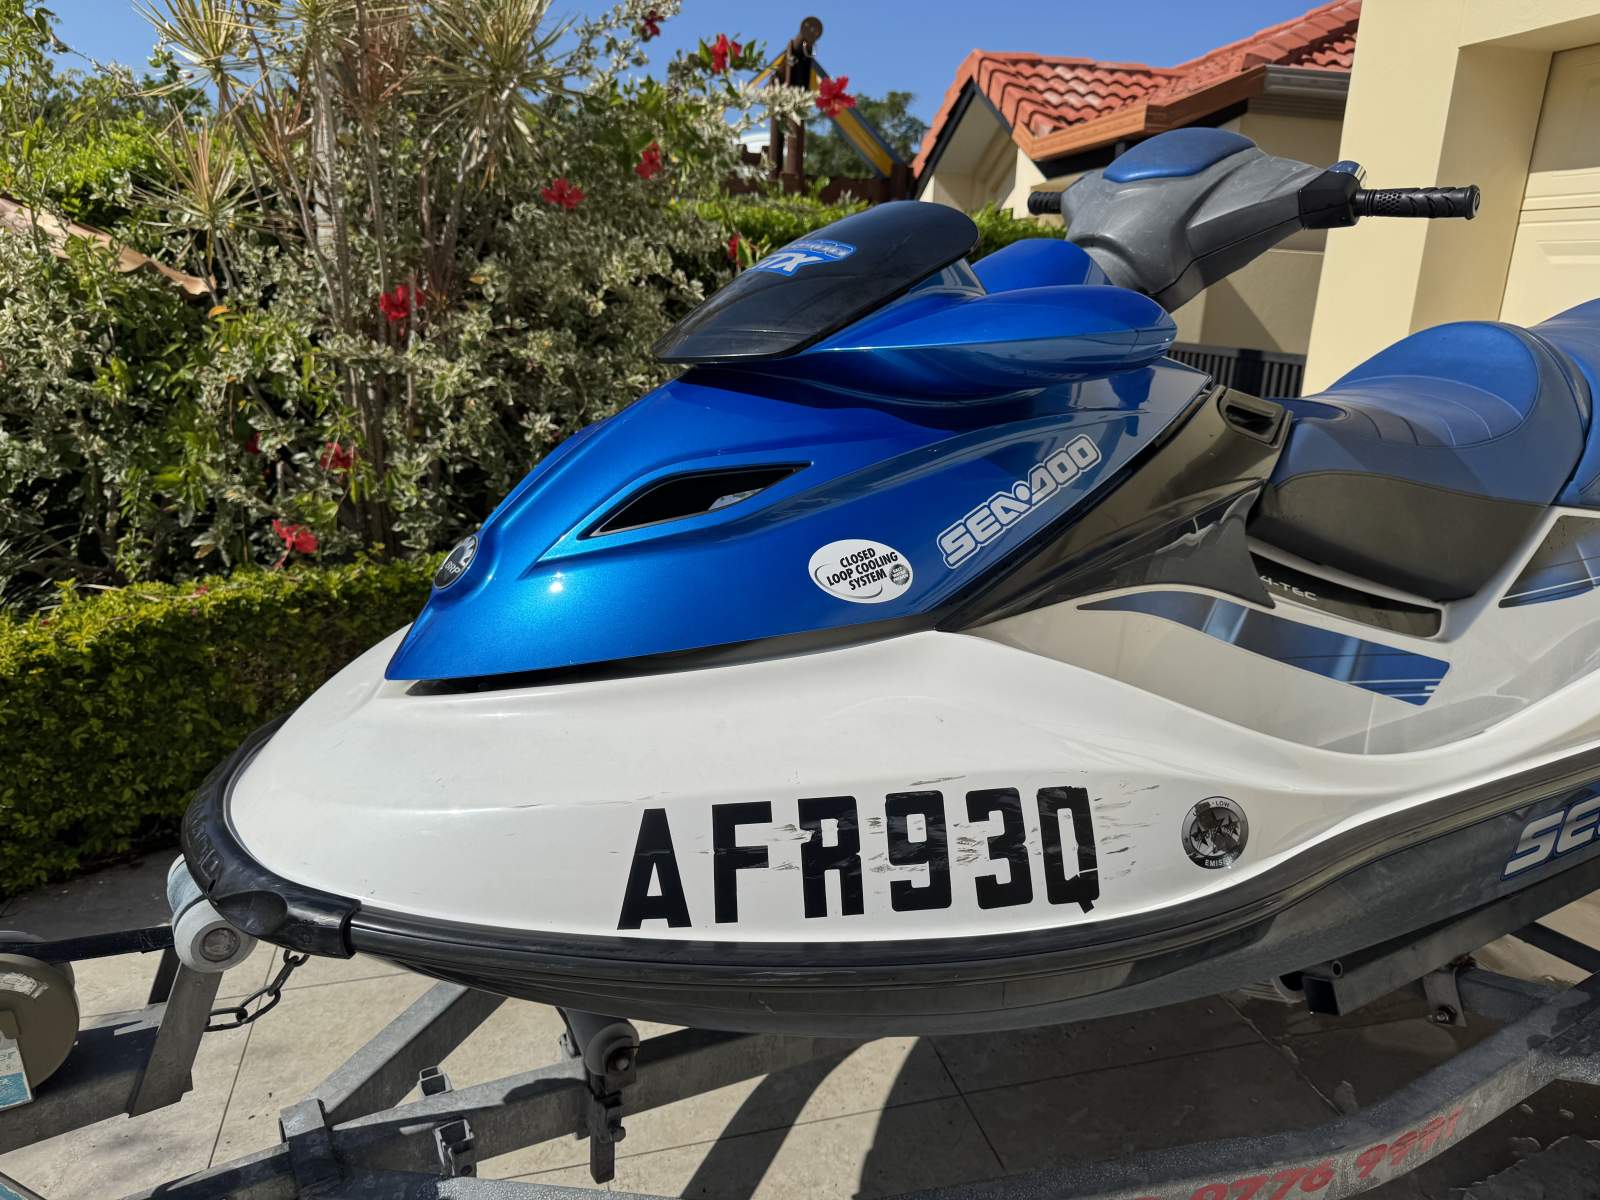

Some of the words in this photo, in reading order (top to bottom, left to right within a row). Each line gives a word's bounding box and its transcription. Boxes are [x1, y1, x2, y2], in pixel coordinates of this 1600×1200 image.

[826, 568, 854, 587] LOOP
[855, 551, 898, 575] COOLING
[840, 548, 876, 568] CLOSED
[848, 568, 888, 591] SYSTEM
[1259, 575, 1318, 601] 4-TEC
[1215, 800, 1230, 808] LOW
[1500, 793, 1600, 881] SE
[616, 786, 1100, 931] AFR93Q
